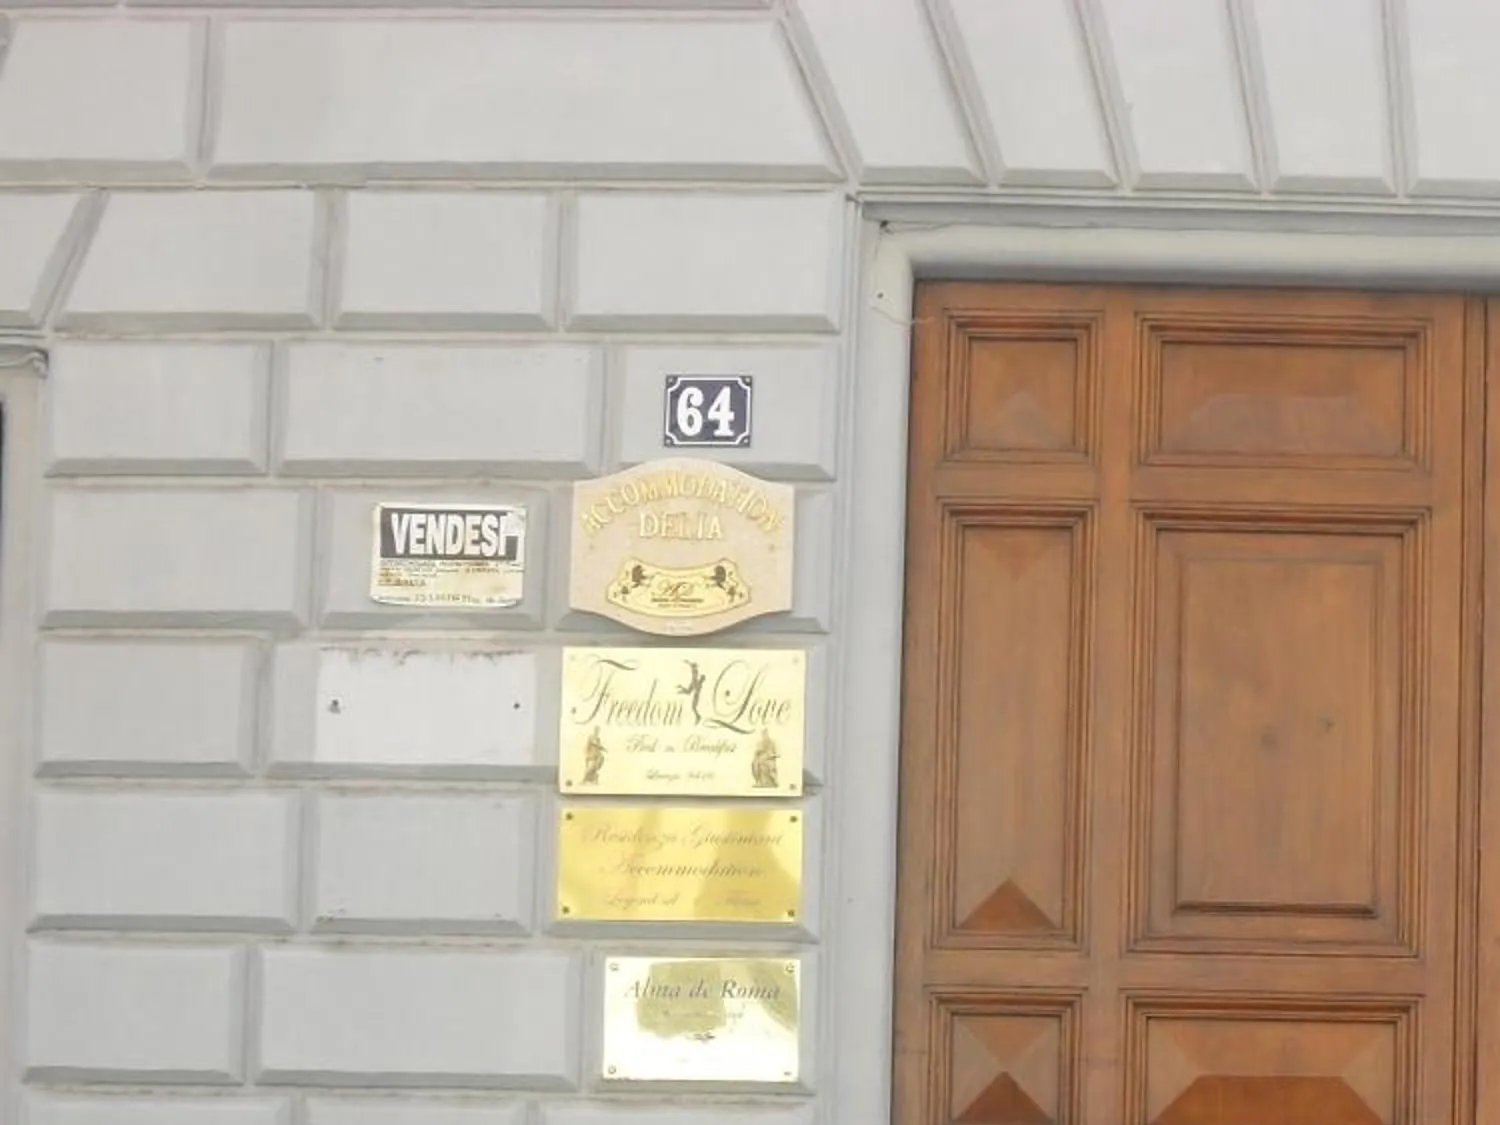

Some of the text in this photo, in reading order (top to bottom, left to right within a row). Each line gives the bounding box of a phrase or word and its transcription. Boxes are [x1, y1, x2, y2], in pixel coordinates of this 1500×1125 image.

[677, 386, 734, 437] 64
[391, 511, 507, 557] VENDESI
[574, 654, 793, 735] Freedom Love
[720, 975, 782, 1000] Roma
